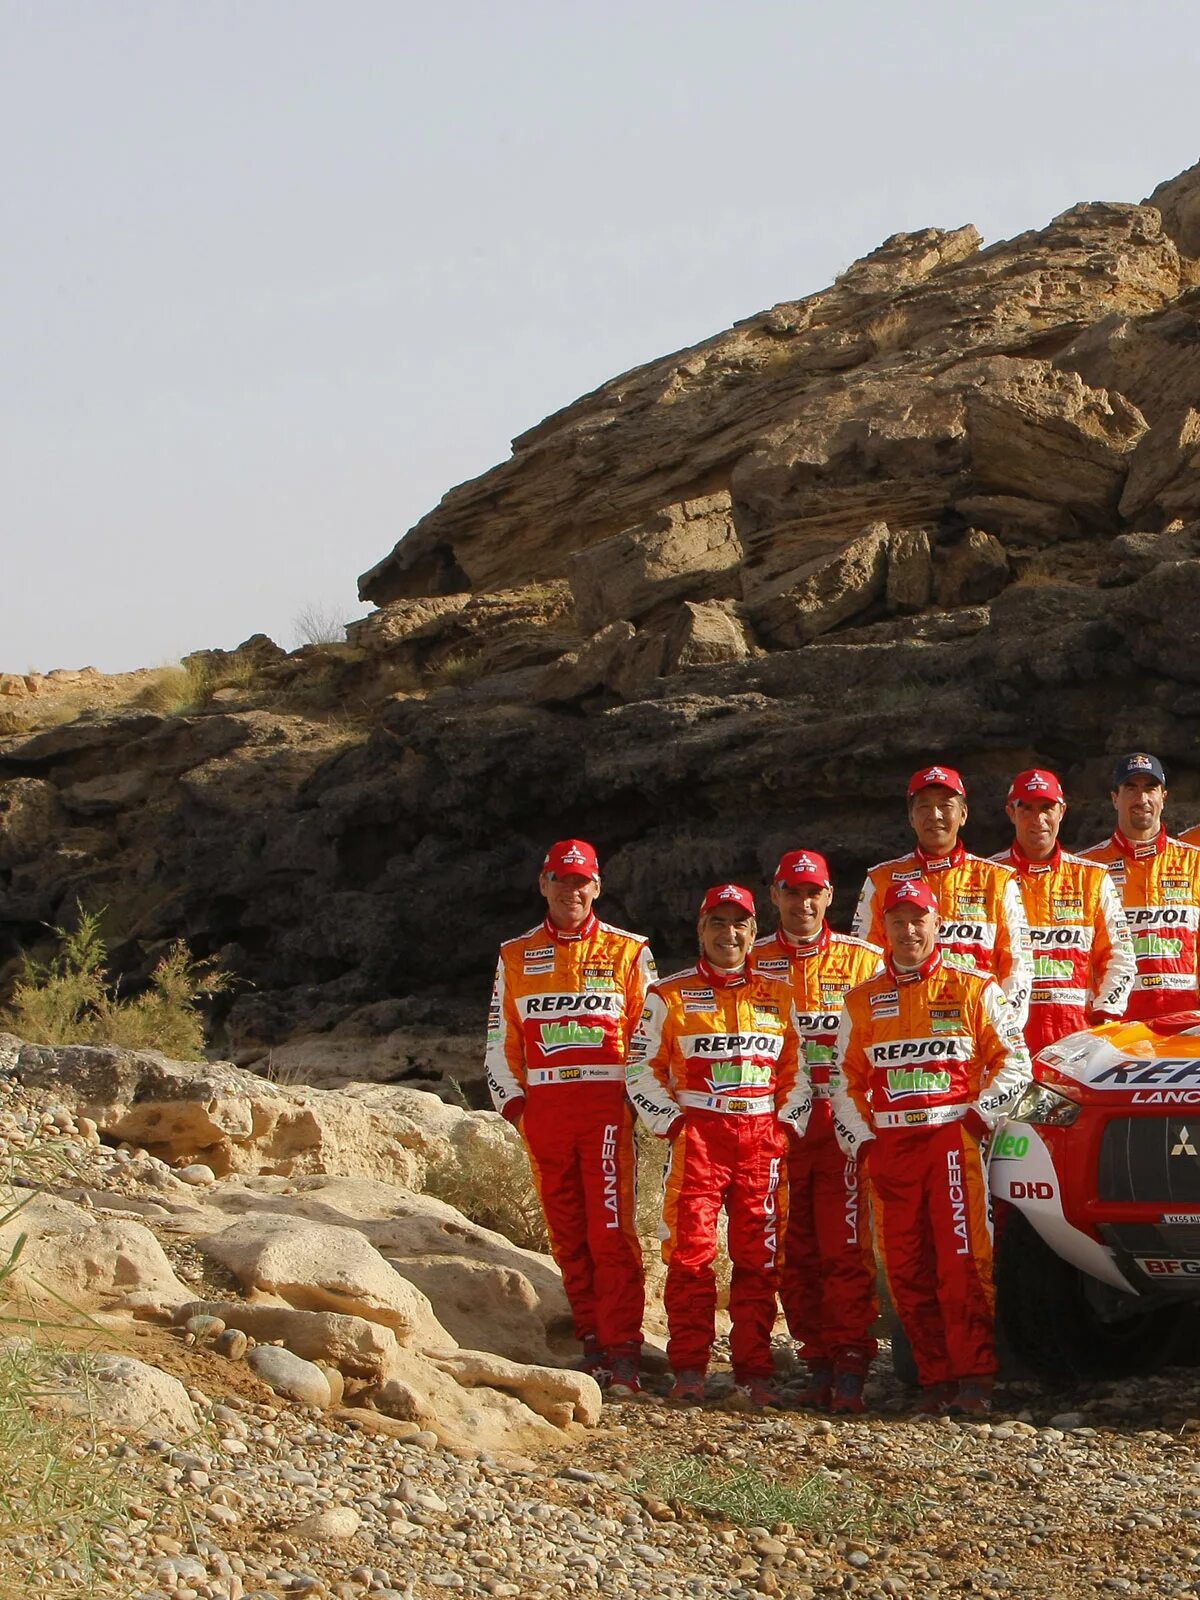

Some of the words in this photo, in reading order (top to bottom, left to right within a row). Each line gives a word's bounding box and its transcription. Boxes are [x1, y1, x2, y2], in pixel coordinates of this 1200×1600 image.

[1126, 909, 1189, 924] EPSOL
[939, 923, 983, 941] PSOL
[1031, 929, 1081, 945] PSOL
[1142, 977, 1161, 986] OMP
[526, 995, 612, 1014] REPSOL
[1031, 992, 1050, 1000] OMP
[799, 1014, 840, 1031] PSO
[541, 1022, 605, 1045] Valeo
[694, 1035, 777, 1053] REPSOL
[873, 1040, 958, 1062] REPSOL
[560, 1069, 580, 1079] OMP
[710, 1061, 772, 1084] Valeo
[887, 1068, 951, 1091] Valeo
[633, 1093, 676, 1119] REPSOL
[728, 1099, 748, 1111] OMP
[981, 1081, 1027, 1112] REPSOL
[906, 1112, 927, 1122] OMP
[993, 1131, 1029, 1158] leo
[601, 1124, 619, 1229] LANCER
[947, 1150, 969, 1254] LANCER
[764, 1157, 781, 1269] LANCER
